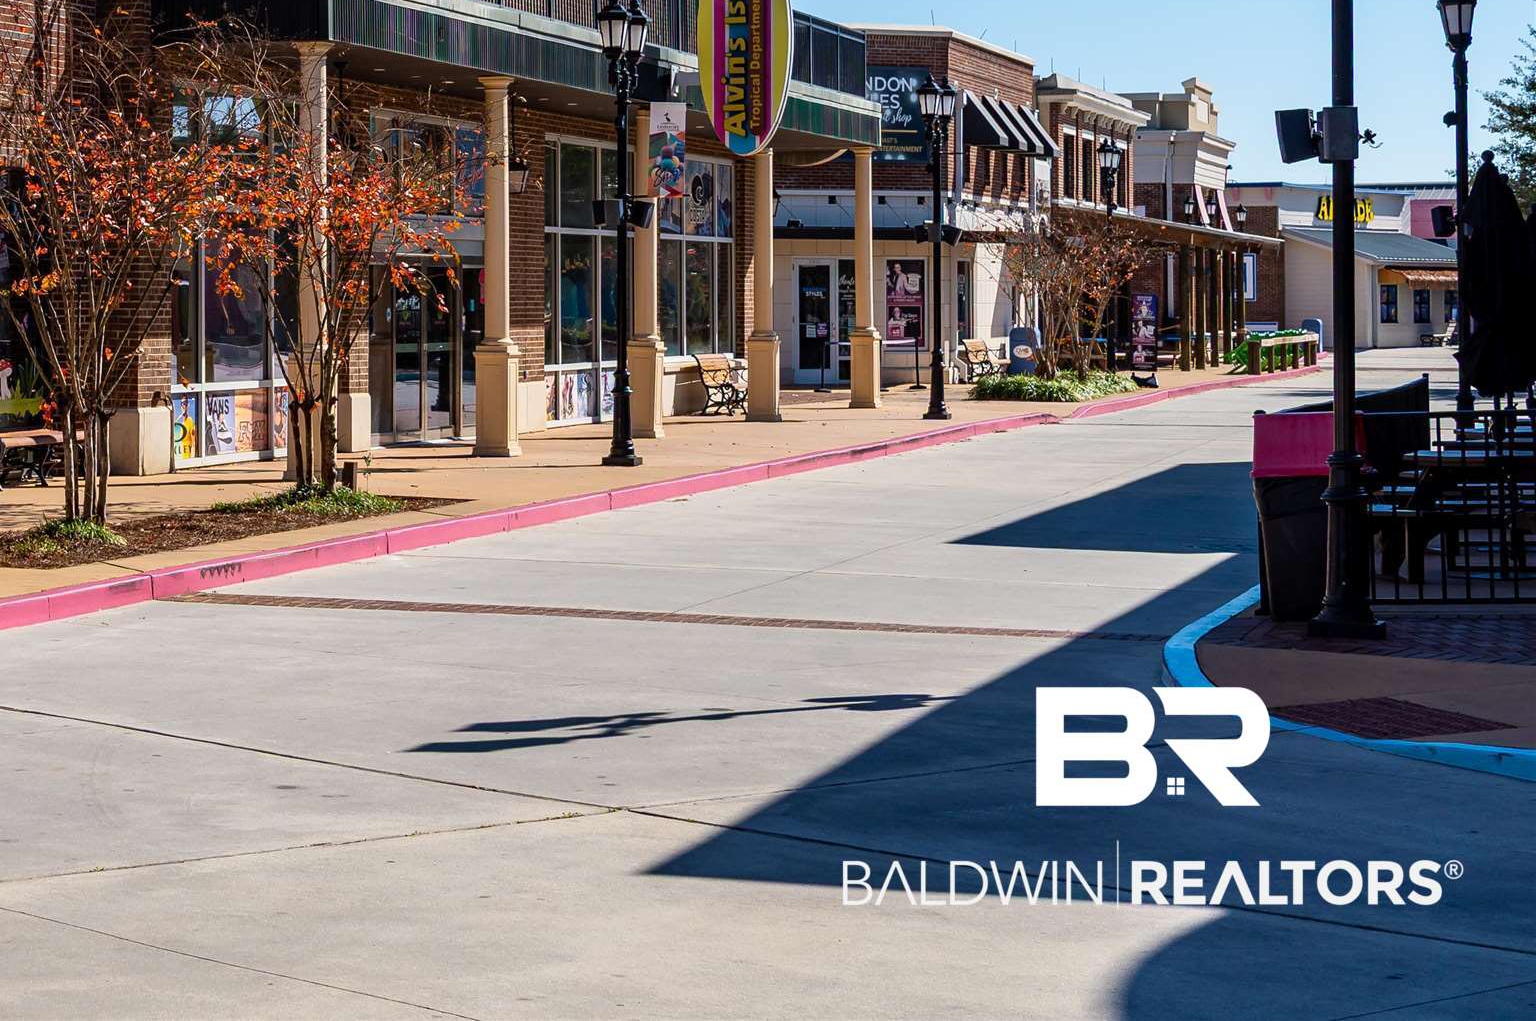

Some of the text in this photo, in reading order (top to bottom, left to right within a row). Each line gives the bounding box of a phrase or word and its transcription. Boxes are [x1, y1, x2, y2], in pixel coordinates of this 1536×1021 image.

[721, 37, 746, 137] Alvin's
[750, 72, 762, 130] Tropical
[865, 76, 913, 92] NDON
[207, 398, 230, 418] VANS
